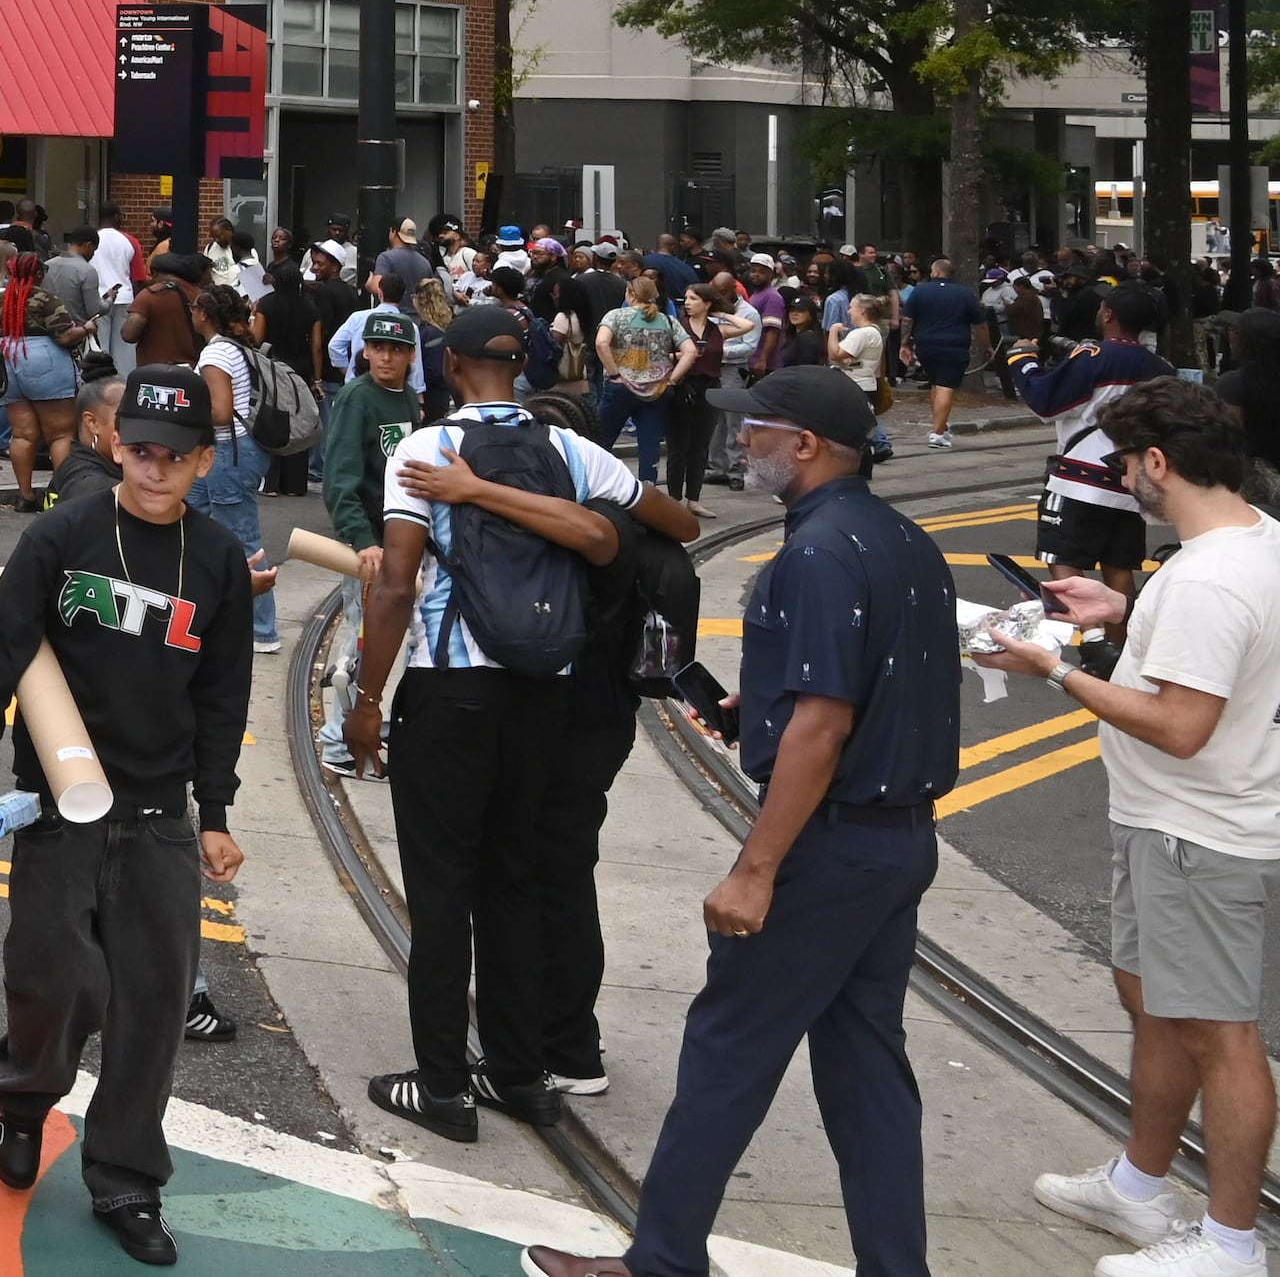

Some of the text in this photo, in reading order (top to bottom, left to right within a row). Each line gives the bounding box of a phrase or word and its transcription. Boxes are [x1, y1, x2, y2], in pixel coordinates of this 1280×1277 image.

[140, 15, 156, 23] Young
[137, 383, 190, 408] ATL
[57, 570, 202, 653] ATL
